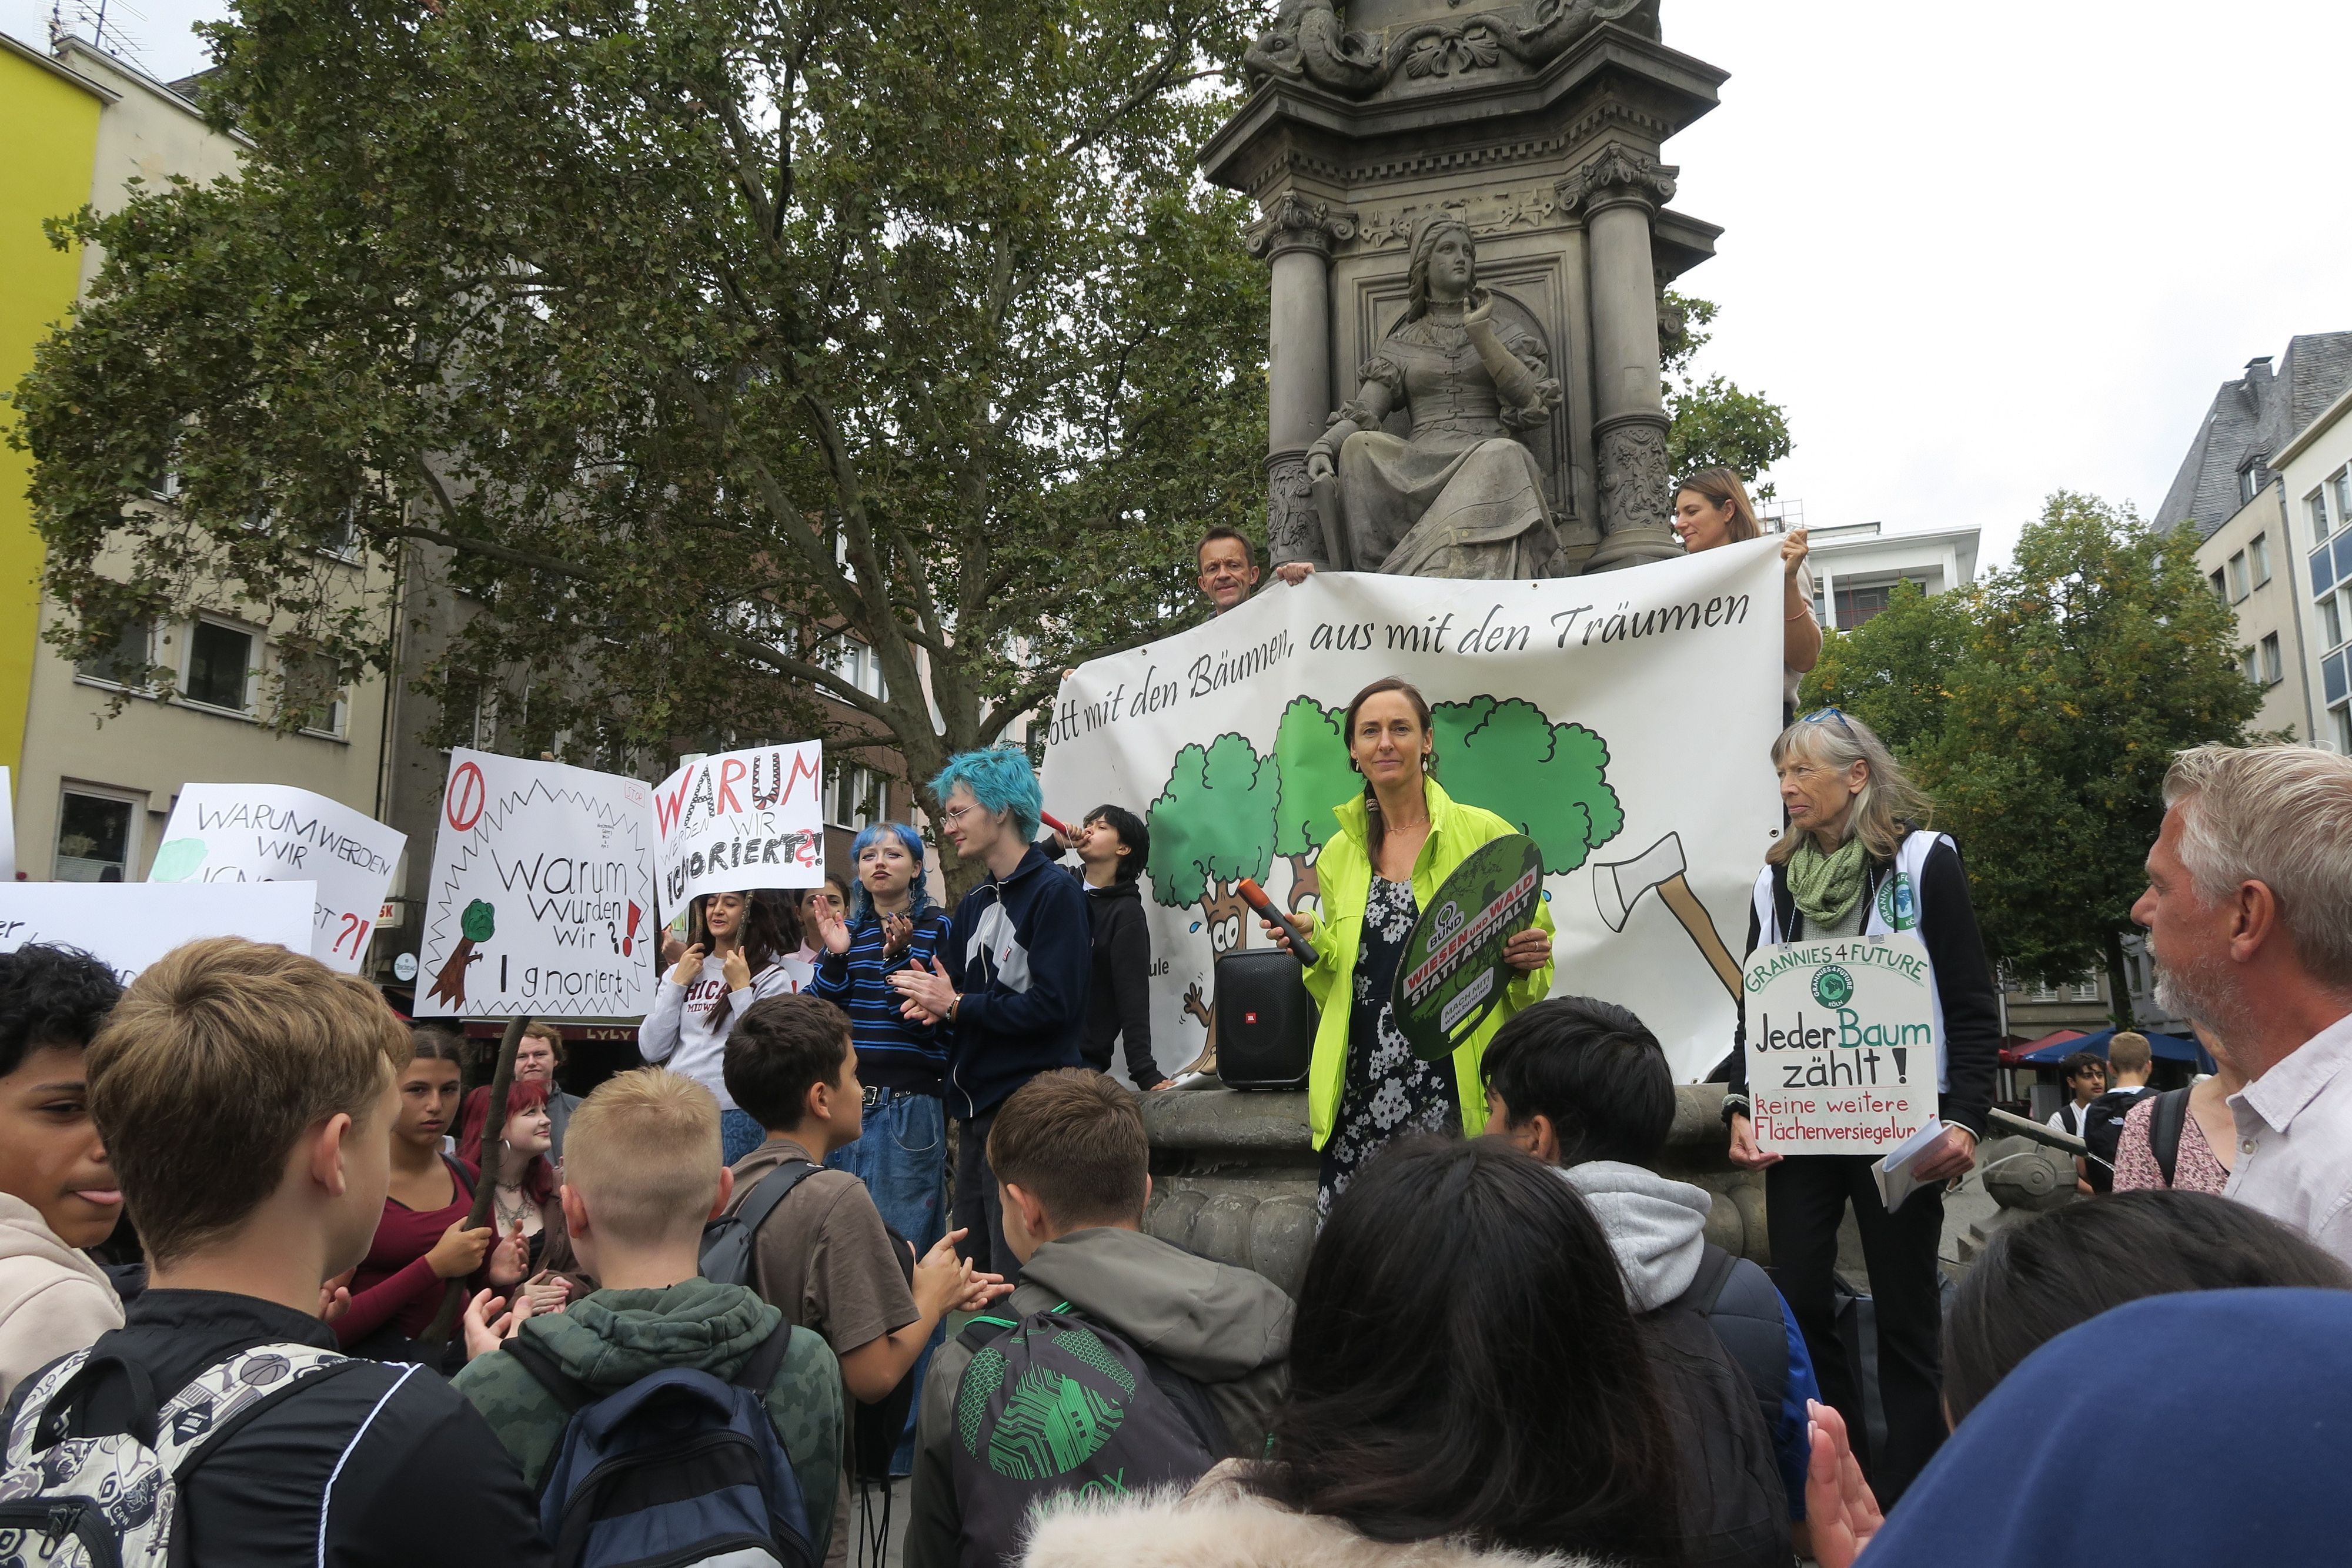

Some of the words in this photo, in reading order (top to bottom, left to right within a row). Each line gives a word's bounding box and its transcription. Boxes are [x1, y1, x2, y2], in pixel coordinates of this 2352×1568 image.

[1050, 700, 1080, 745] ott
[1084, 684, 1124, 731] mit
[1130, 665, 1177, 717] den
[1188, 628, 1294, 698] Bäumen,
[1310, 621, 1373, 651] aus
[1385, 613, 1455, 653] mit
[1458, 604, 1530, 654] den
[1551, 594, 1750, 650] Träumen
[627, 787, 643, 800] STOP
[655, 749, 820, 844] WARUM
[199, 803, 318, 842] WARUM
[319, 825, 391, 876] WERDEN
[258, 836, 308, 870] WIR
[660, 818, 709, 865] WERDEN
[729, 813, 776, 837] WIR
[491, 849, 627, 895] Warum
[379, 905, 393, 918] SK
[1879, 881, 1893, 922] GRANNIE
[1408, 929, 1468, 989] WIESEN
[1470, 917, 1488, 937] UND
[1489, 874, 1534, 918] WALD
[1412, 955, 1458, 1006] STATT
[1462, 892, 1530, 961] ASPHALT
[1430, 916, 1462, 948] BUND
[1148, 958, 1169, 977] ule
[1445, 992, 1470, 1018] MACH
[1472, 975, 1489, 994] MIT!
[587, 1029, 631, 1040] LYLY
[1756, 1011, 1836, 1052] Jeder
[1836, 1008, 1931, 1048] Baum
[1755, 1093, 1815, 1115] keine
[1826, 1091, 1909, 1113] weitere
[1755, 1116, 1916, 1144] Flächenversiegelun
